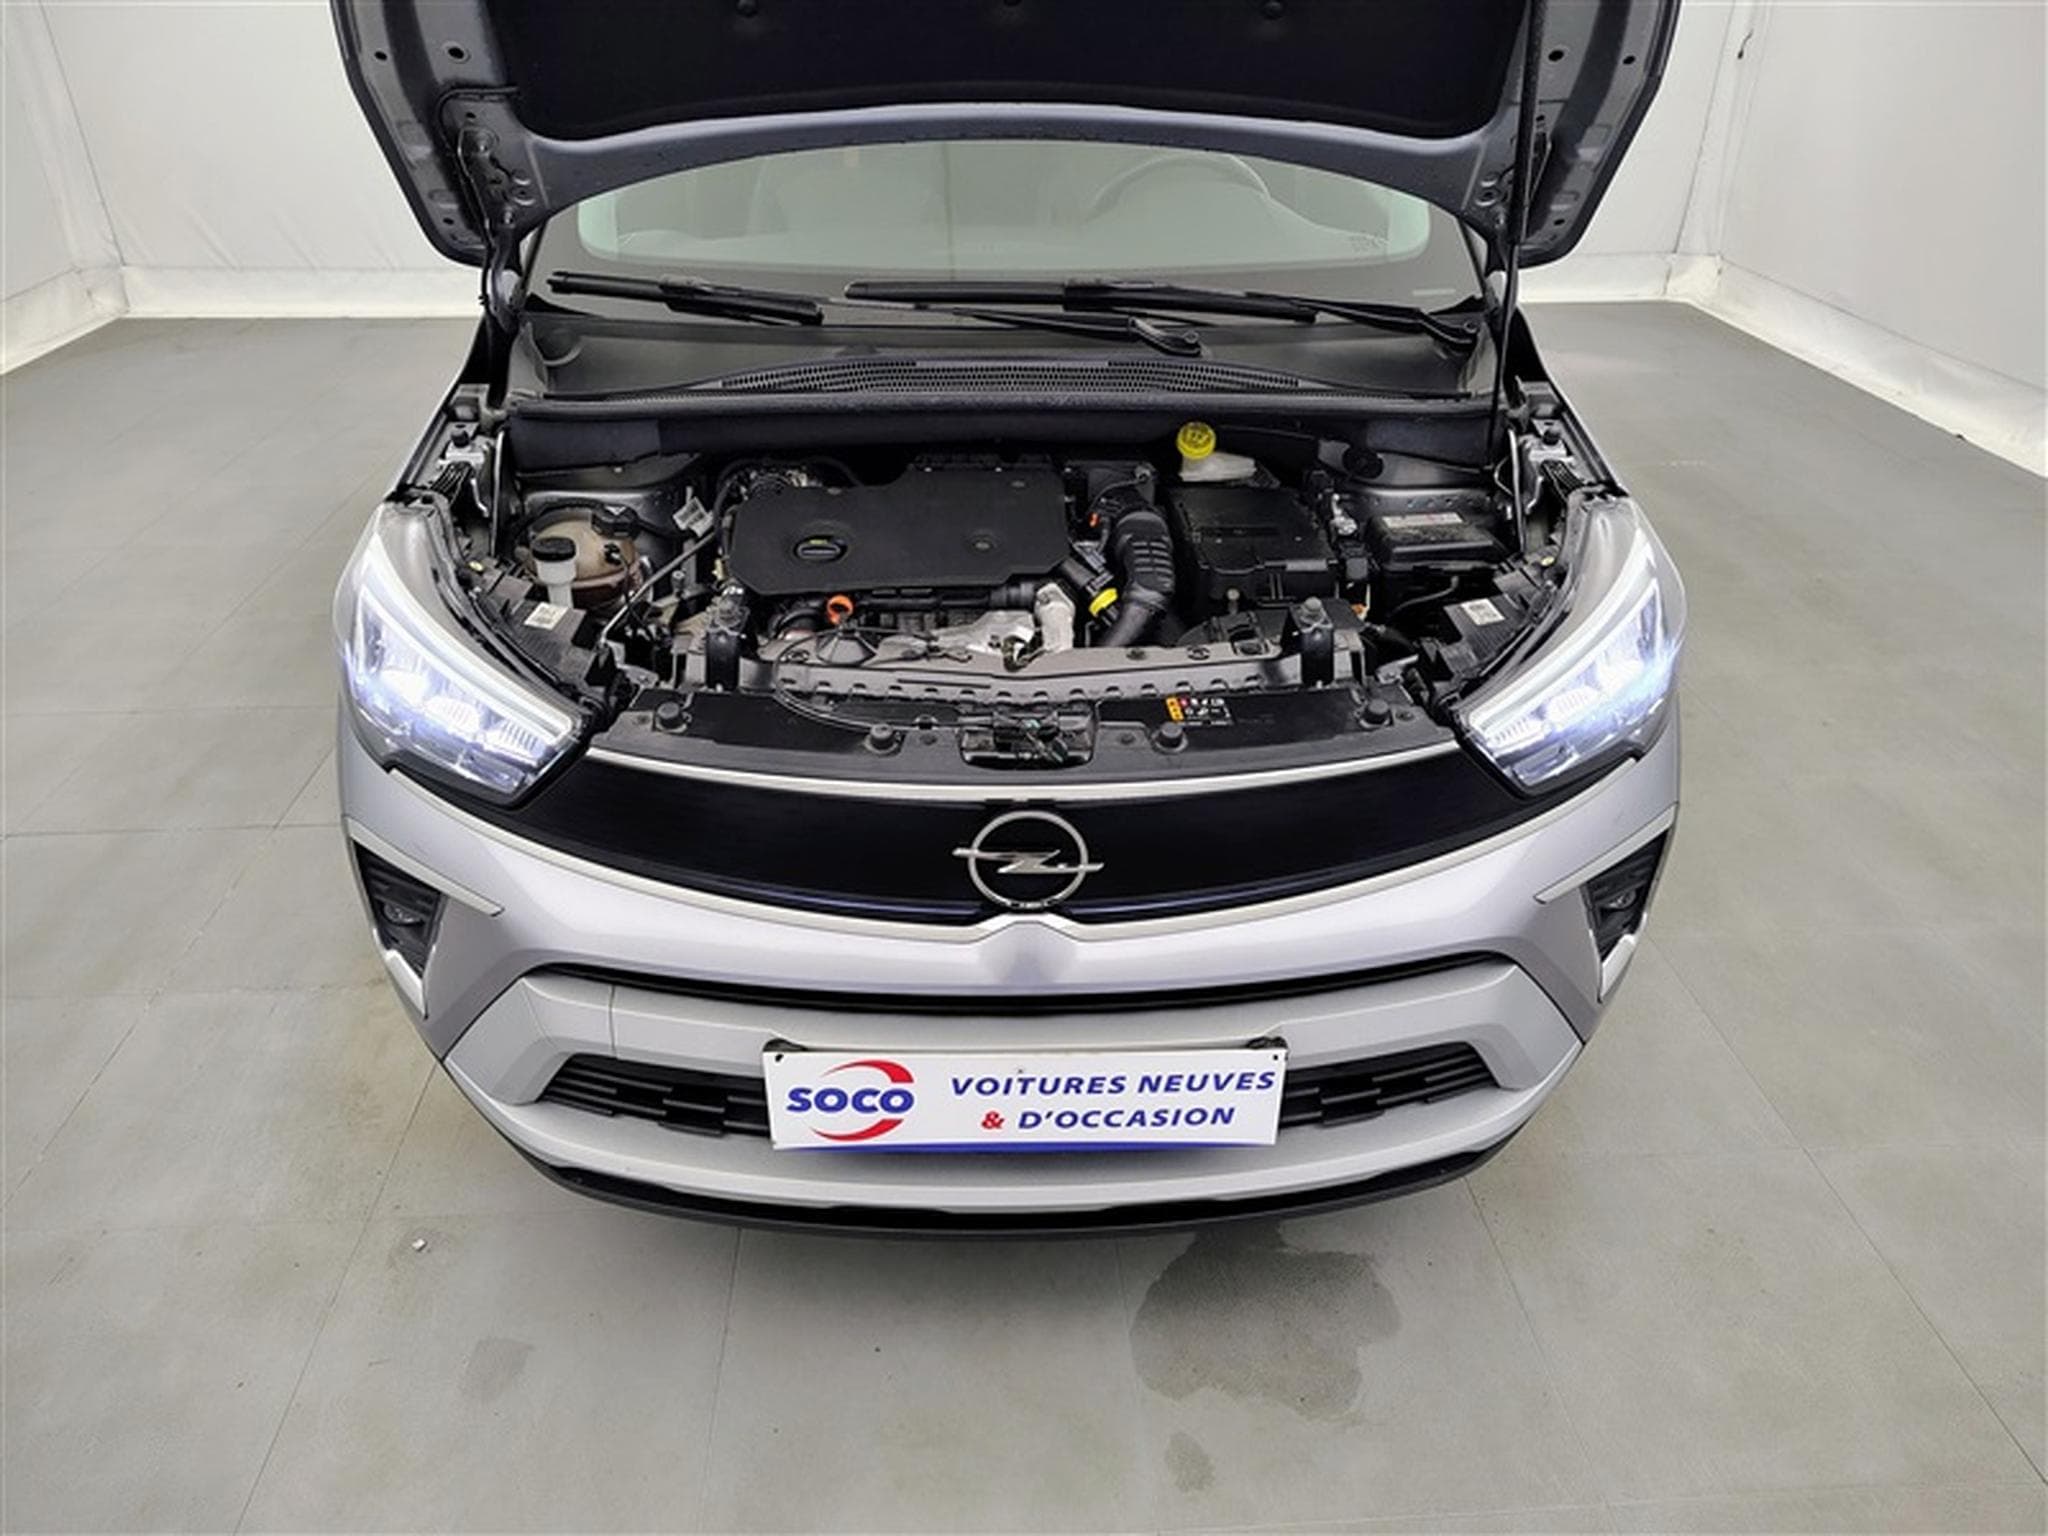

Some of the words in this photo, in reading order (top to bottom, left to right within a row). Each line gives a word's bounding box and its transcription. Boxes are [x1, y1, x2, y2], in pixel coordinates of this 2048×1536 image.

[952, 1076, 1126, 1096] VOITURES
[1138, 1071, 1275, 1093] NEUVES
[787, 1087, 914, 1114] SOCO
[981, 1110, 1004, 1130] &
[1019, 1107, 1234, 1129] D'OCCASION
